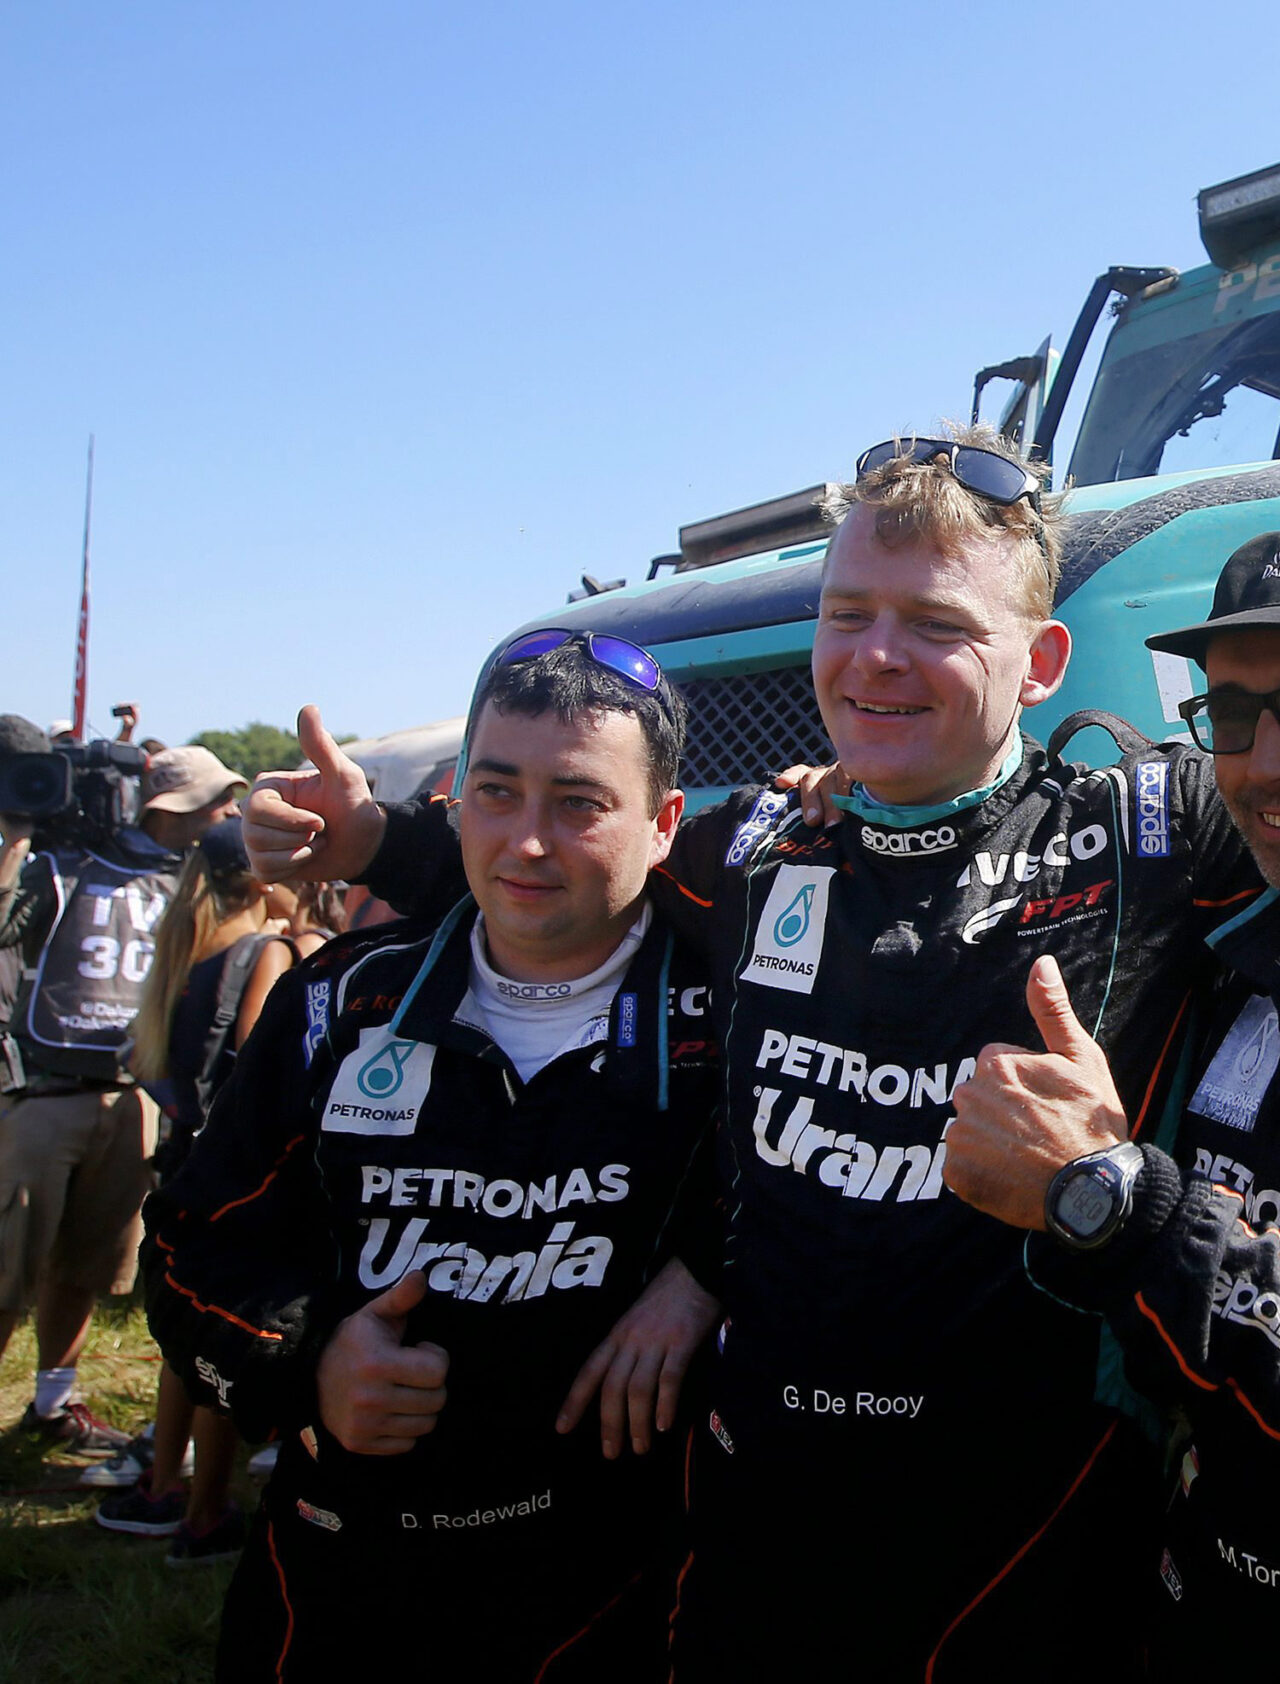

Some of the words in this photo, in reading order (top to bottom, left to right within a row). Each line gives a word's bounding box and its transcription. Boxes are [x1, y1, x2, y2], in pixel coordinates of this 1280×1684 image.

[1140, 763, 1167, 854] sparco
[861, 825, 957, 857] sparco
[956, 824, 1108, 888] IVECO
[86, 884, 166, 932] TV
[1017, 922, 1060, 937] POWERTRAIN
[1061, 908, 1108, 927] TECHNOLOGIES
[1019, 880, 1112, 924] FPT
[752, 953, 815, 976] PETRONAS
[497, 981, 572, 1001] sparco
[622, 996, 634, 1041] sparco
[755, 1029, 974, 1108] PETRONA
[329, 1103, 415, 1121] PETRONAS
[1200, 1082, 1261, 1112] PETRONAS
[752, 1086, 949, 1202] Urani
[360, 1163, 631, 1220] PETRONAS
[357, 1217, 614, 1304] Urania
[783, 1385, 805, 1411] G.
[813, 1389, 846, 1415] De
[856, 1392, 924, 1419] Rooy
[401, 1512, 422, 1529] D.
[432, 1488, 551, 1530] Rodewald
